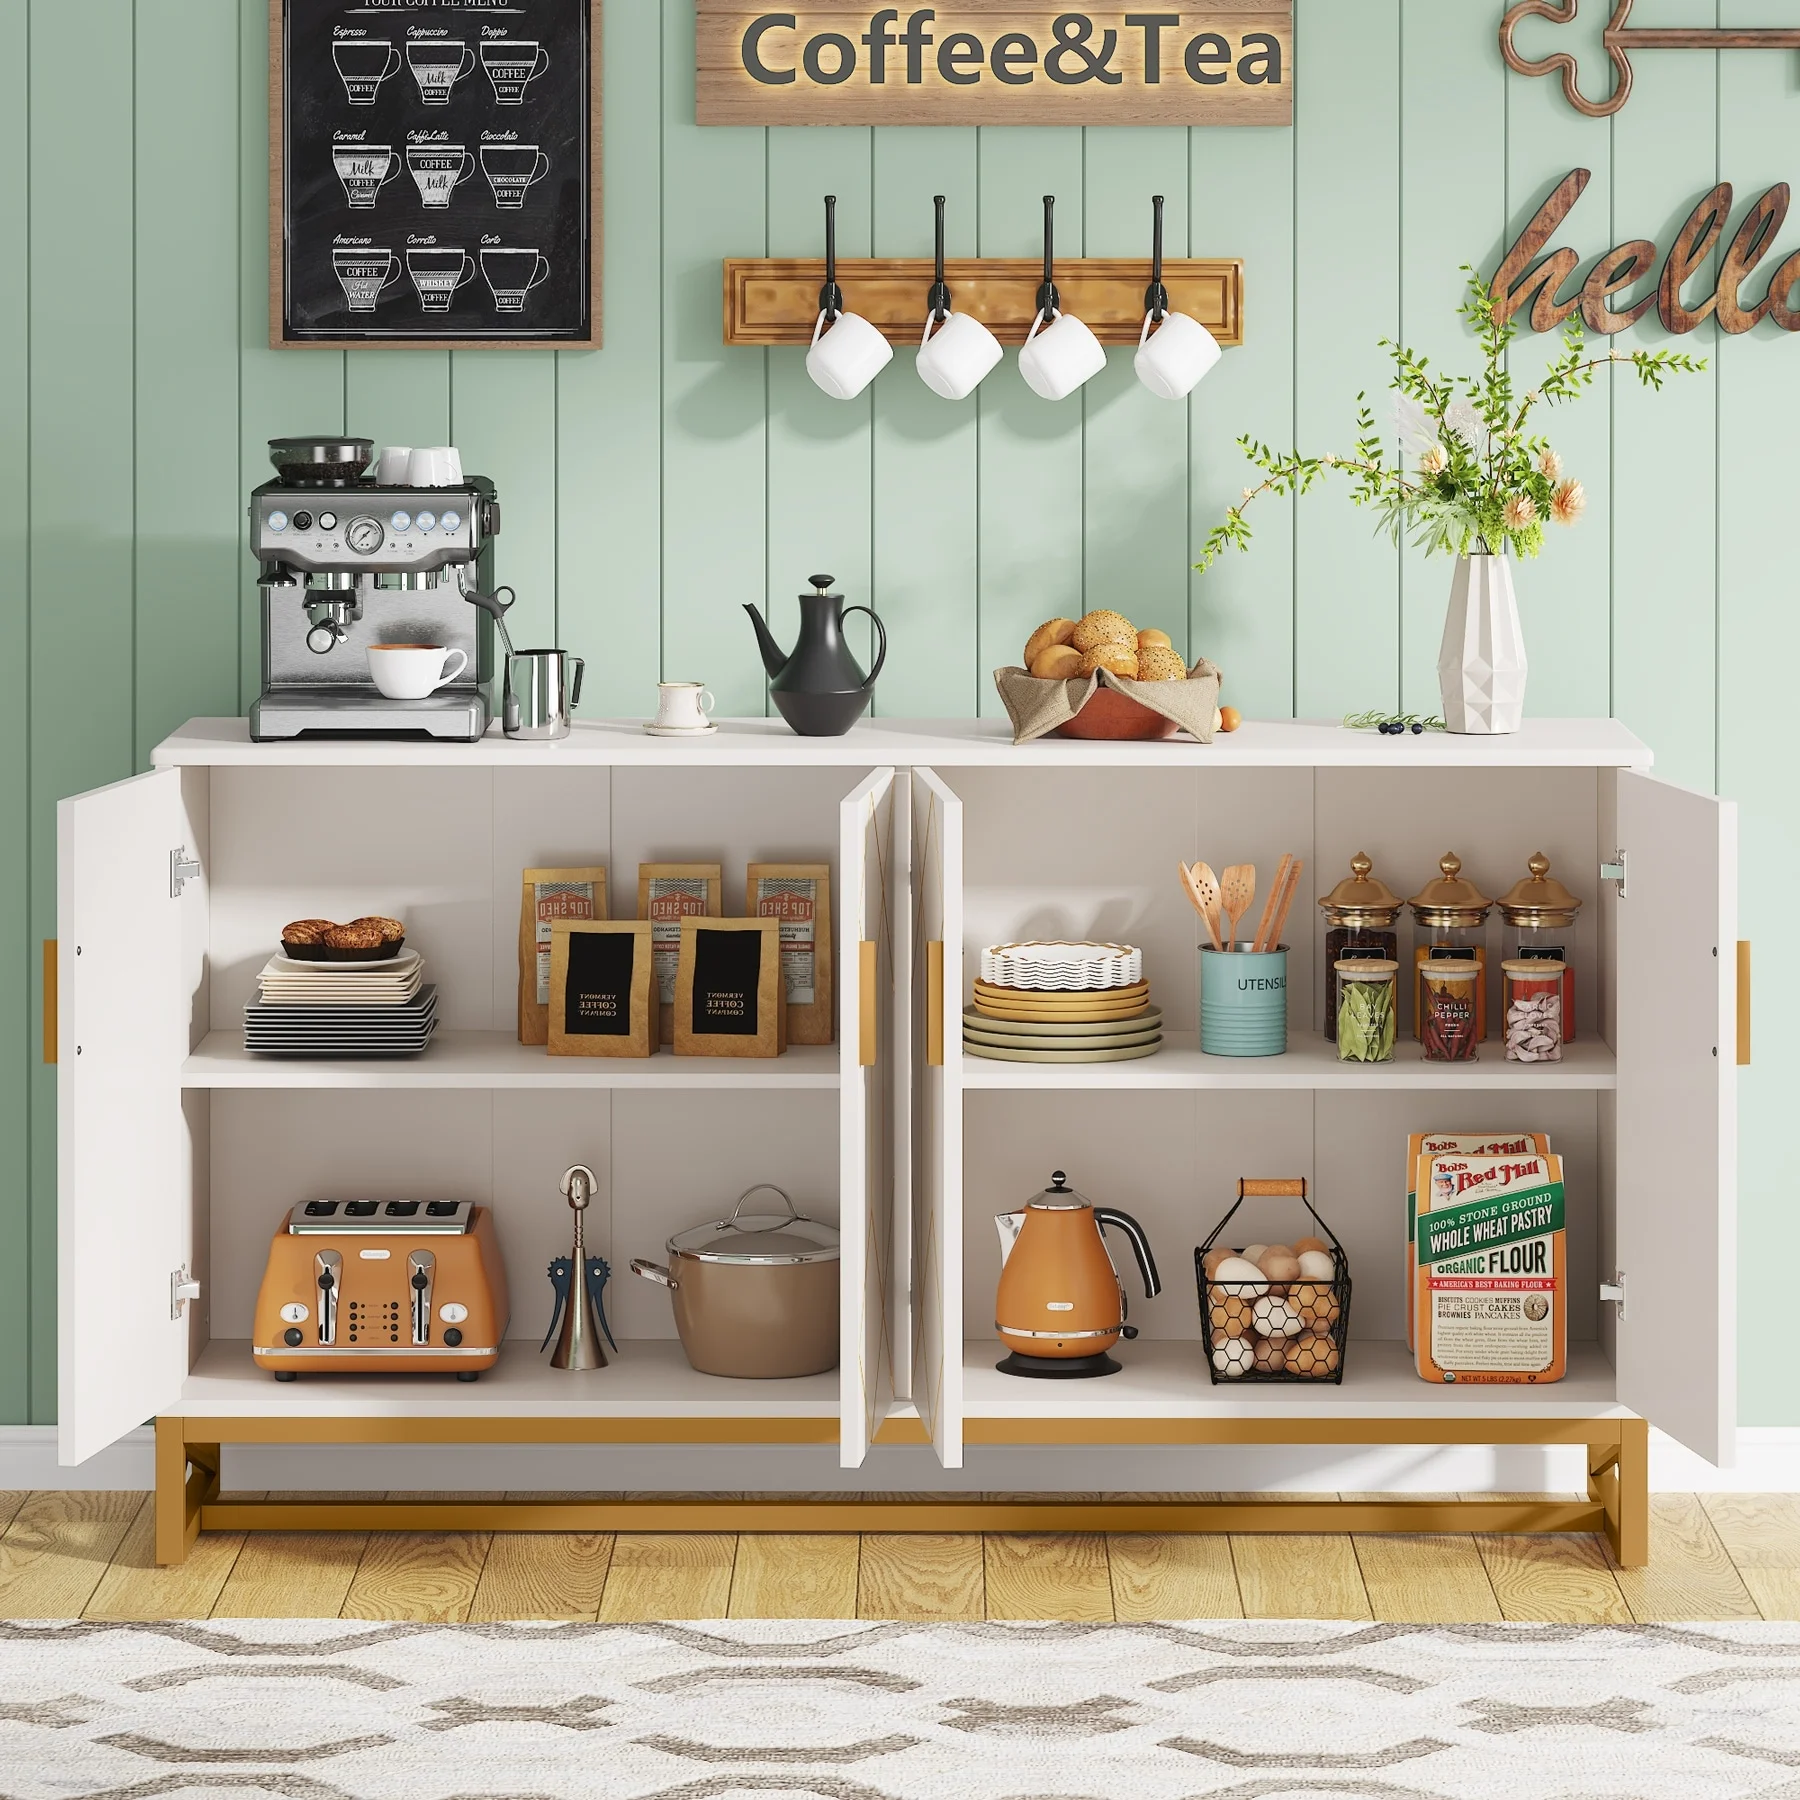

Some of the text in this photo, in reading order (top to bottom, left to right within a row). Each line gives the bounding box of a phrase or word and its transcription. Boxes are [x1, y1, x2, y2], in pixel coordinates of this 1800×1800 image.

[333, 26, 367, 39] Espresso
[406, 26, 448, 39] Cappuccino
[481, 26, 508, 39] Doppio
[741, 9, 1282, 85] Coffee&Tea
[424, 72, 447, 85] Milk
[492, 68, 526, 79] COFFEE
[349, 84, 375, 92] COFFEE
[424, 88, 447, 96] COFFEE
[332, 129, 366, 141] Caramel
[480, 129, 518, 141] Cioccolato
[351, 160, 375, 175] Milk
[419, 159, 452, 169] COFFEE
[349, 179, 375, 187] COFFEE
[425, 176, 450, 190] Milk
[496, 189, 522, 198] COFFEE
[332, 233, 372, 245] Americano
[406, 233, 437, 245] Corretto
[480, 233, 501, 245] Corto
[346, 267, 378, 277] COFFEE
[418, 279, 453, 287] WHISKEY
[349, 291, 375, 299] WATER
[423, 293, 448, 302] COFFEE
[498, 297, 521, 305] COFFEE
[1238, 976, 1286, 990] UTENSIL
[1434, 1011, 1470, 1019] PEPPER
[1456, 1166, 1497, 1196] Red
[1499, 1160, 1539, 1186] Mill
[1429, 1192, 1552, 1232] 100% STONE GROUND
[1430, 1204, 1553, 1254] WHOLE WHEAT PASTRY
[1437, 1240, 1547, 1274] ORGANIC FLOUR
[1521, 1281, 1543, 1289] FLOUR
[1437, 1311, 1521, 1320] BROWNIES PANCAKES
